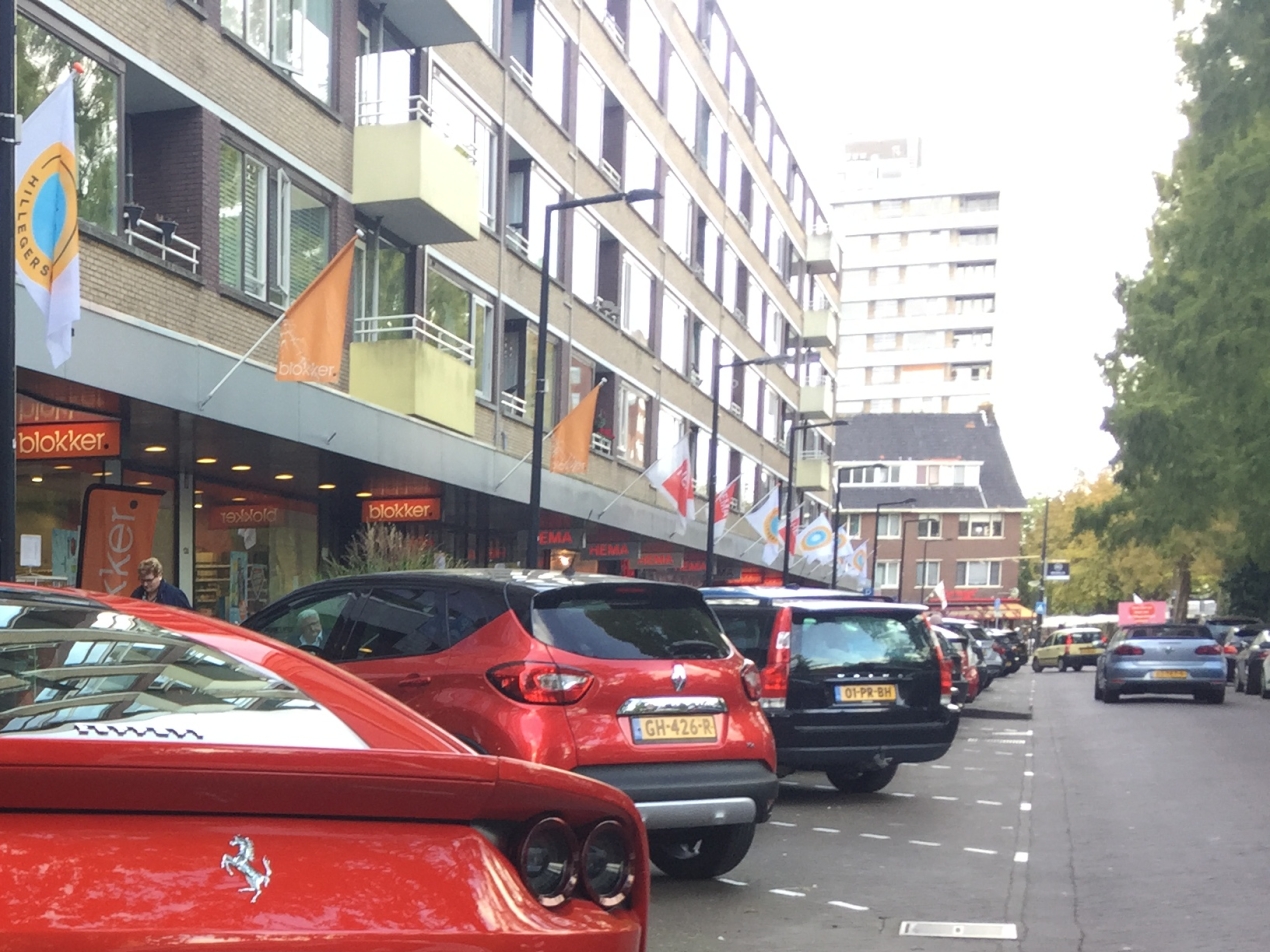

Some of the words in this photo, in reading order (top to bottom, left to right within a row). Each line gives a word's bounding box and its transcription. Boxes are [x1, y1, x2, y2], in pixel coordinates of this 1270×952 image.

[17, 174, 50, 277] HILLEGERS
[538, 531, 573, 546] EMA
[589, 543, 629, 556] HEMA
[845, 687, 892, 699] 01-PR-BH
[645, 718, 713, 737] GH-426-R
